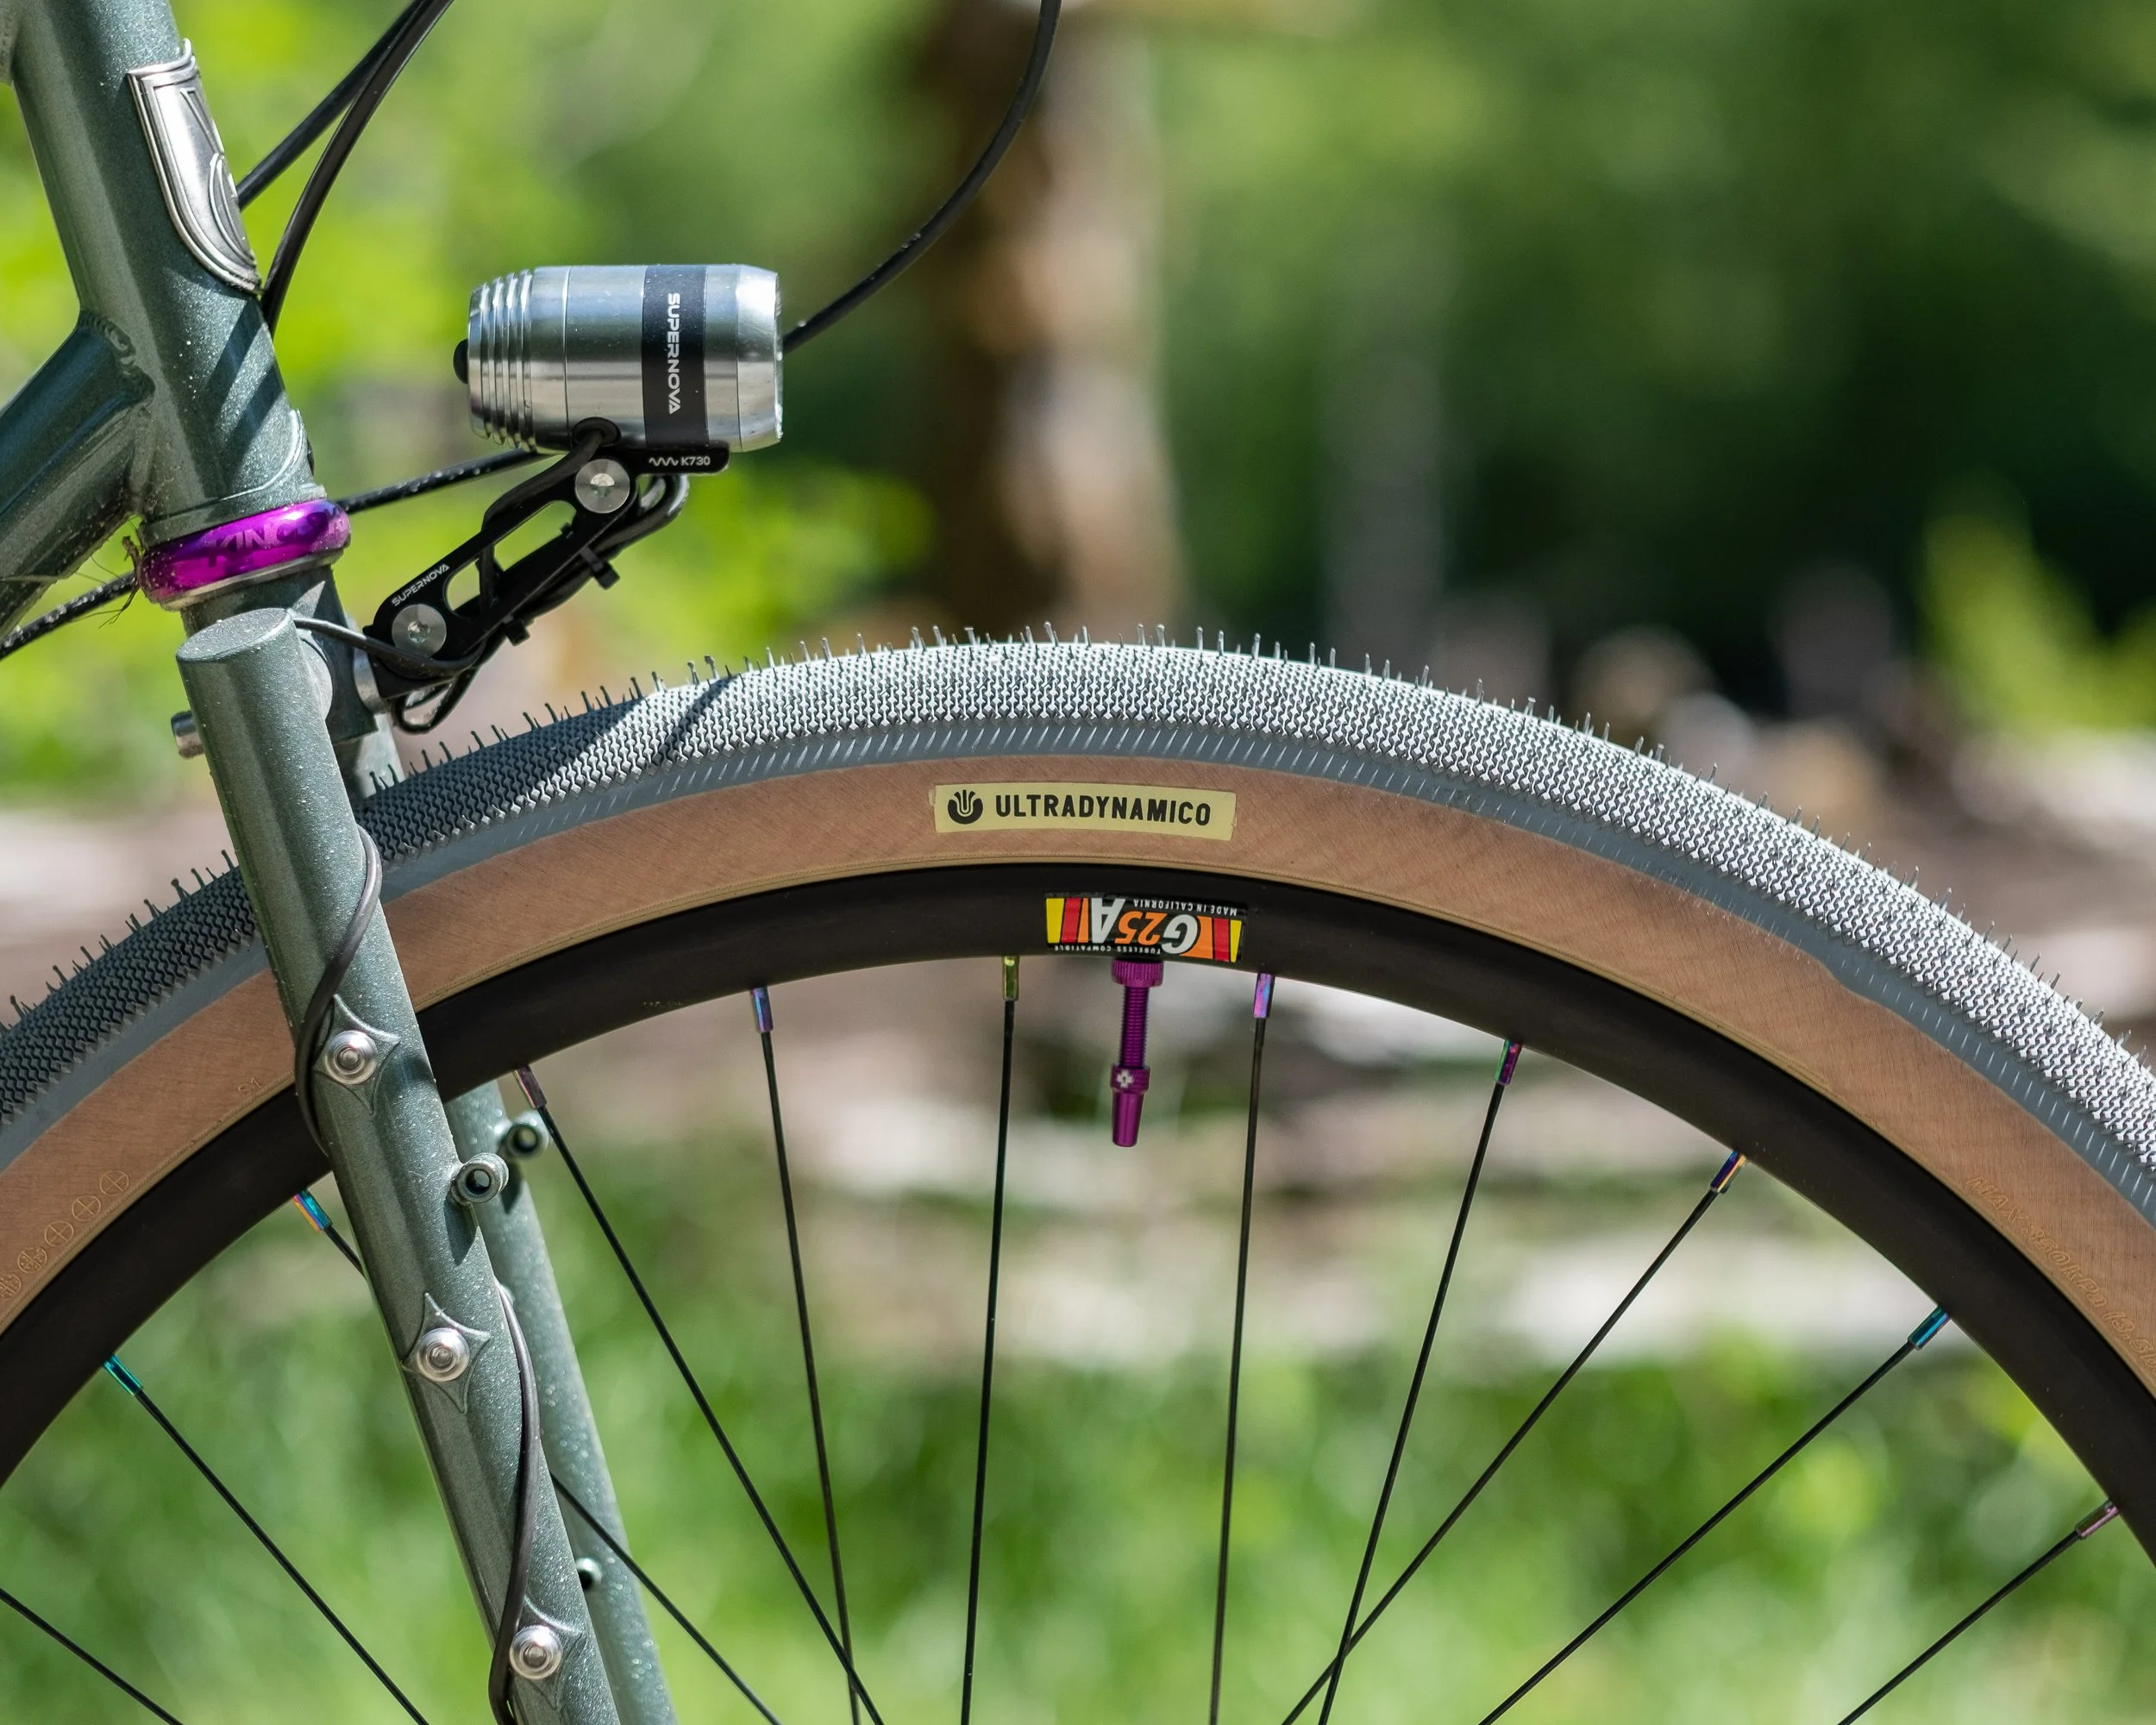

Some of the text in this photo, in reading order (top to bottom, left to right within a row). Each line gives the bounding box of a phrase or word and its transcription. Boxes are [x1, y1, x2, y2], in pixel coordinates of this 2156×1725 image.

[667, 293, 681, 414] SUPERNOVA
[681, 456, 711, 466] K730
[392, 563, 449, 606] SUPERNOVA
[995, 794, 1211, 825] ULTRADYNAMICO
[1133, 899, 1194, 911] CALIFORNIA
[1210, 905, 1237, 916] MADE
[1091, 898, 1198, 955] G25A
[1117, 945, 1161, 954] TUBELESS
[238, 1077, 261, 1097] S1
